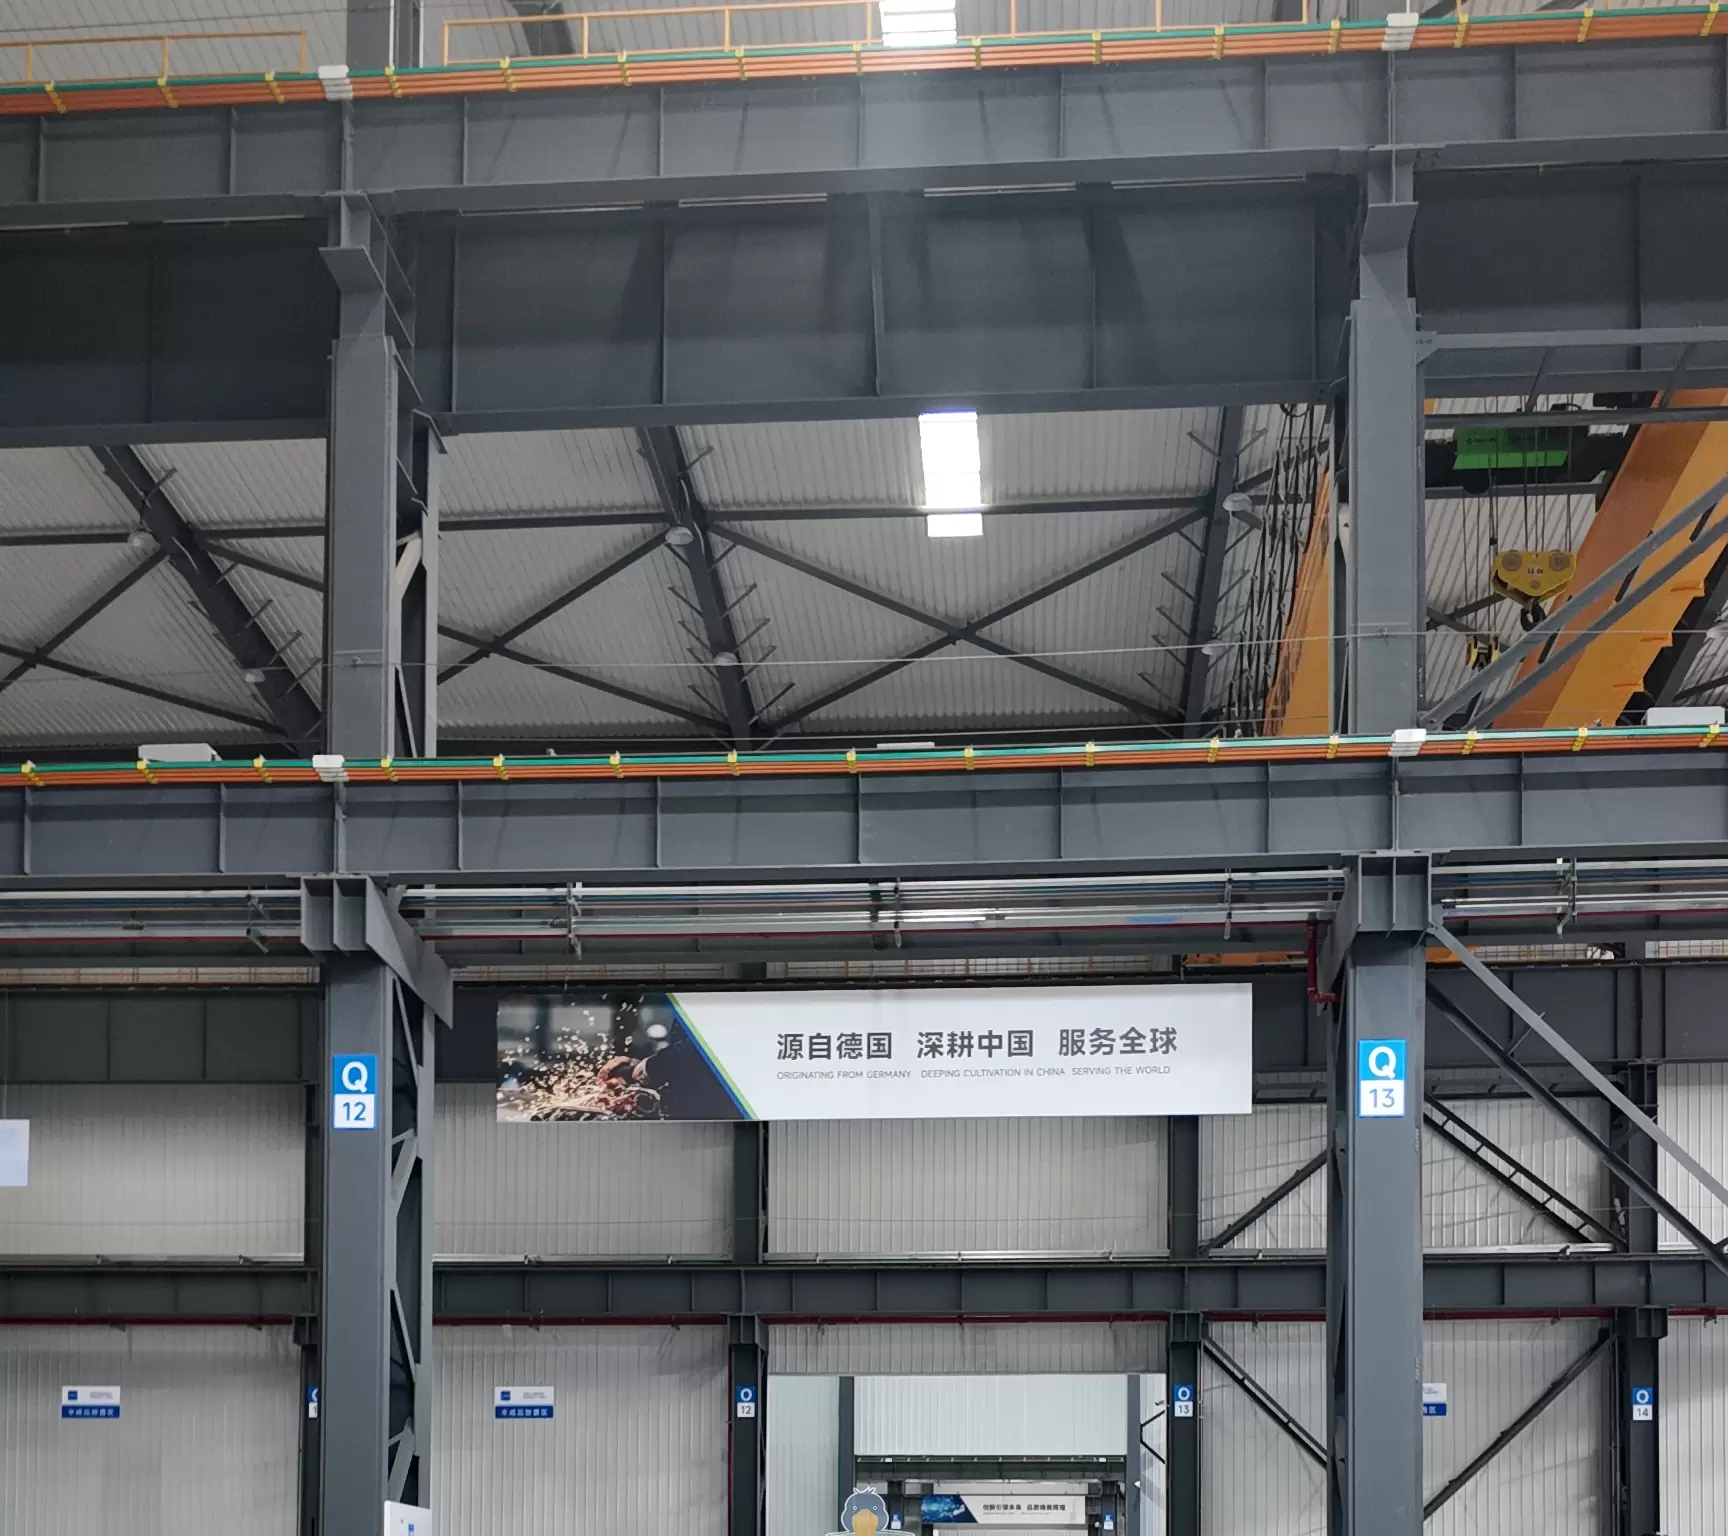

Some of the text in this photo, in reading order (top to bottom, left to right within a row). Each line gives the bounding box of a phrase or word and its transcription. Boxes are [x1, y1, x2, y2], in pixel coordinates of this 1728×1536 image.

[777, 1026, 1178, 1060] 源自德国 深耕中国 服务全球
[1368, 1045, 1397, 1080] Q
[341, 1060, 368, 1093] Q
[776, 1071, 835, 1080] ORIGINATING
[837, 1070, 864, 1079] FROM
[866, 1070, 912, 1079] GERMANY
[920, 1069, 961, 1079] DEEPING
[1023, 1067, 1034, 1077] IN
[1036, 1067, 1066, 1077] CHINA
[1071, 1066, 1111, 1076] SERVING
[1115, 1066, 1132, 1075] THE
[1135, 1065, 1171, 1075] WORLD
[1368, 1088, 1395, 1109] 13
[342, 1101, 367, 1121] 12
[740, 1388, 753, 1402] O
[1177, 1386, 1191, 1401] O
[1636, 1389, 1650, 1404] O
[740, 1405, 752, 1415] 12
[1178, 1404, 1190, 1414] 13
[1636, 1407, 1649, 1417] 14
